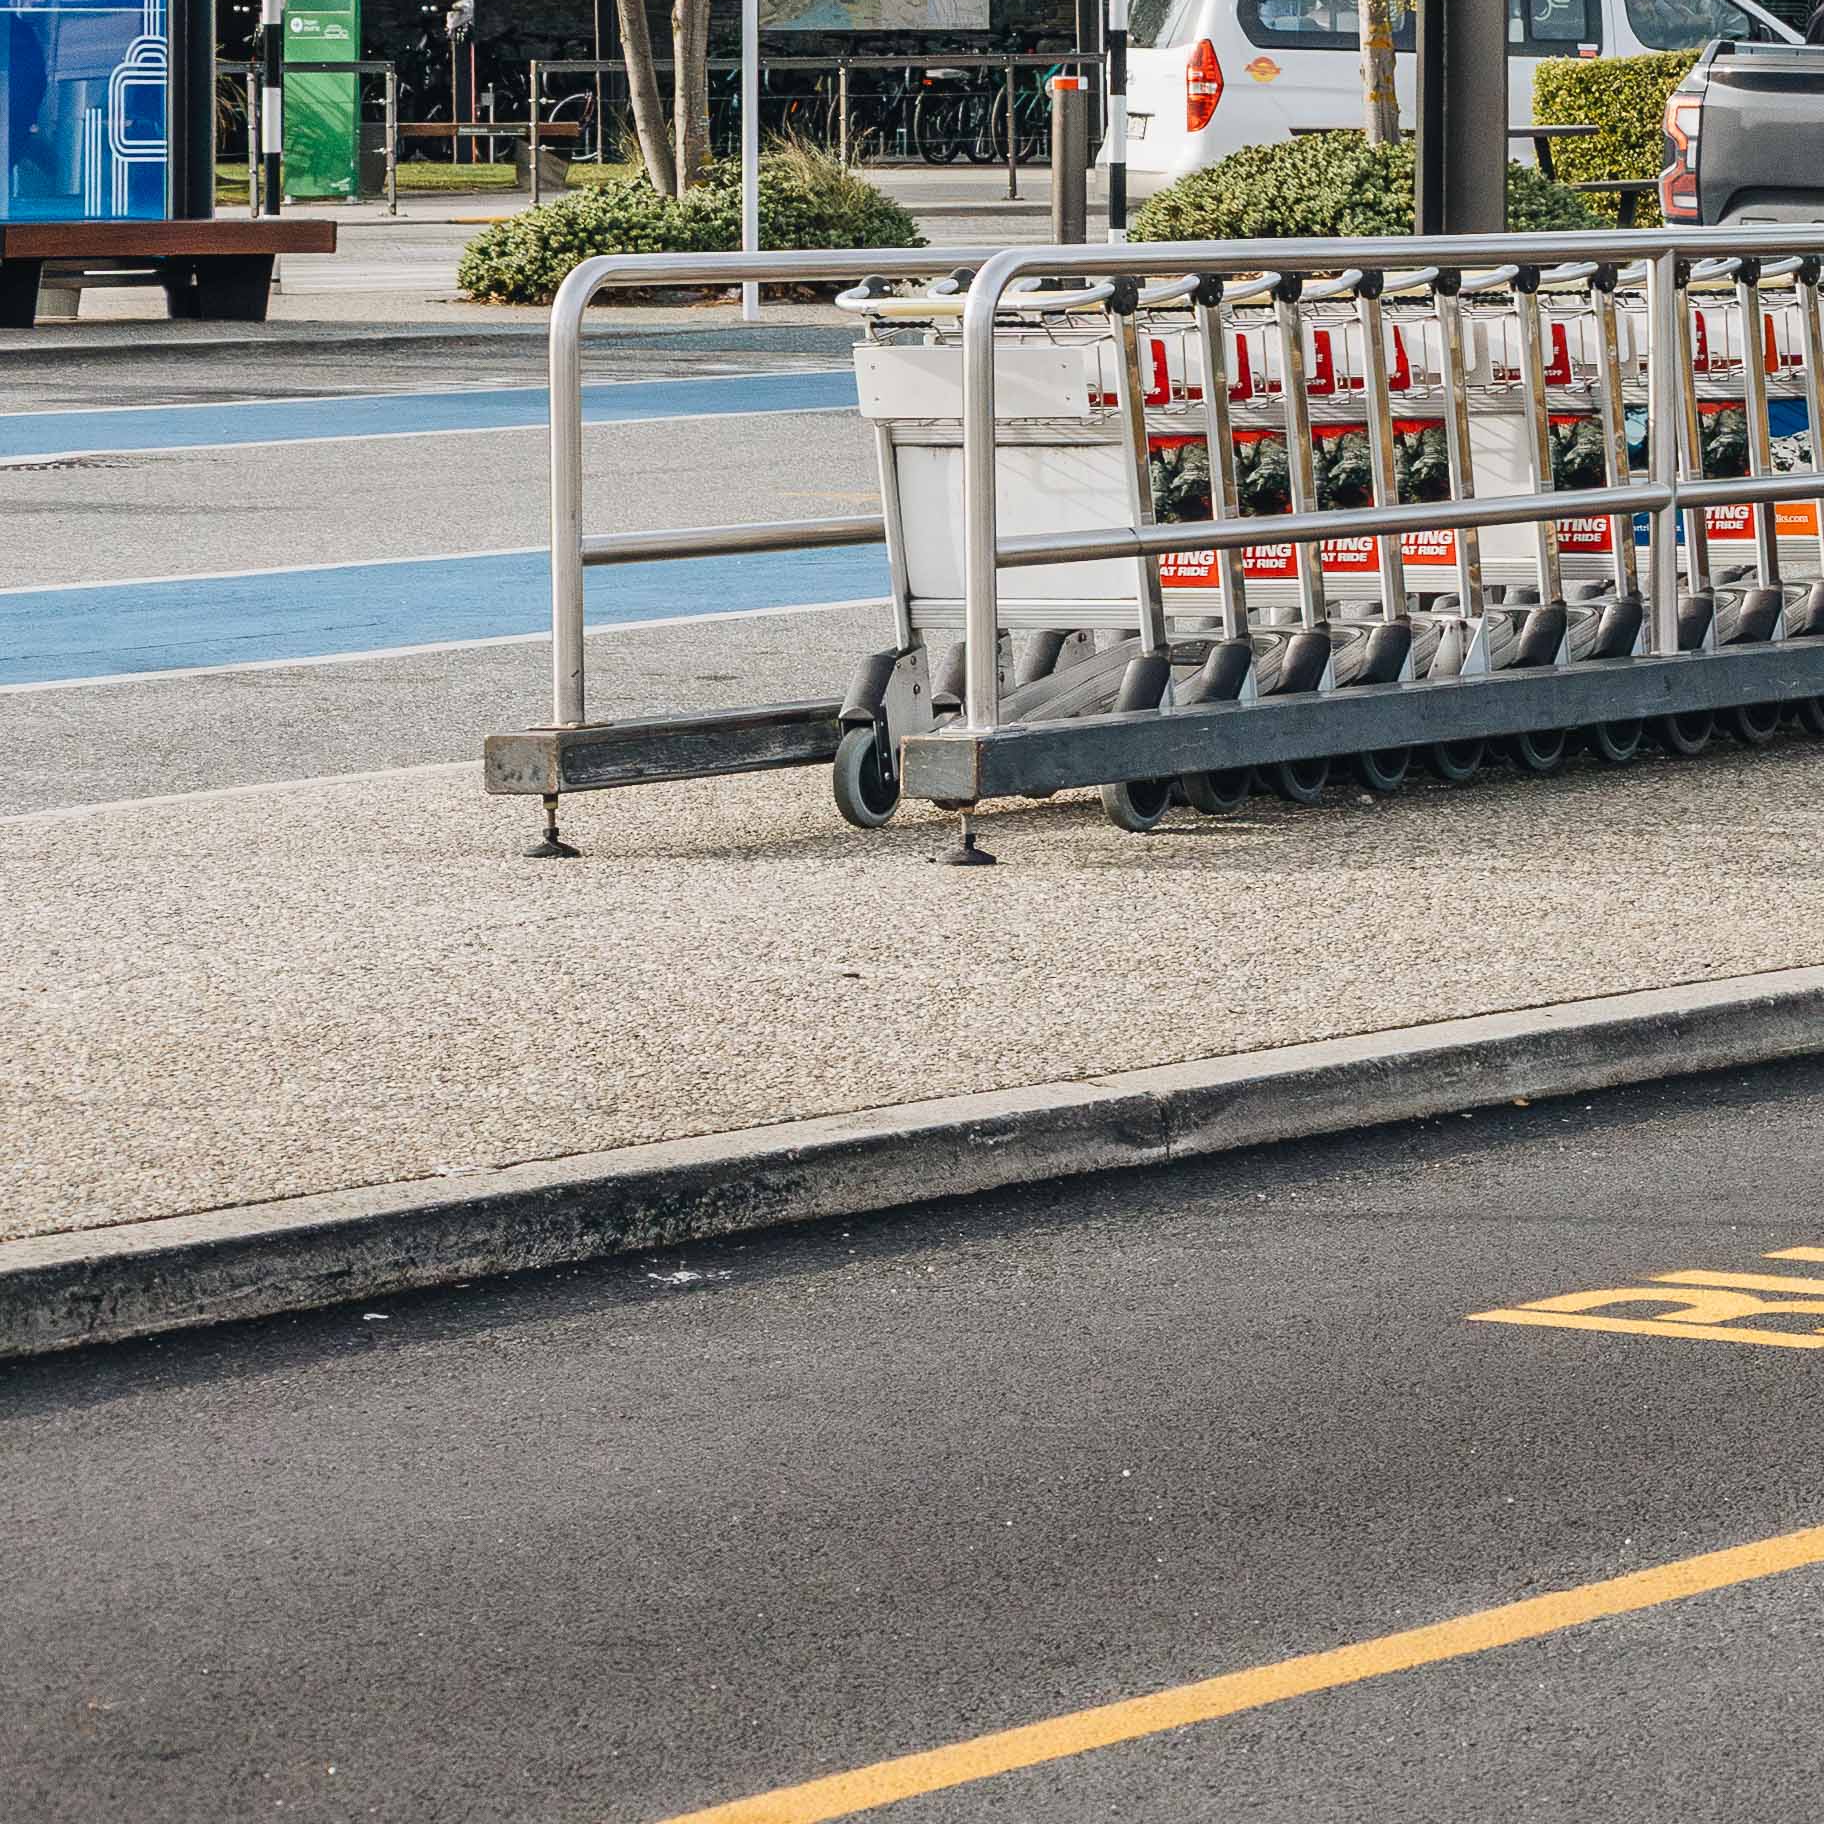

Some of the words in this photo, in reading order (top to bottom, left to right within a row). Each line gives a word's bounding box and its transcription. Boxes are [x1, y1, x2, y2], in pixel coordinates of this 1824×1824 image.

[1715, 520, 1744, 530] RIDE
[1572, 532, 1602, 542] RIDE
[1418, 545, 1448, 555] RIDE
[1337, 552, 1367, 562] RIDE
[1256, 558, 1286, 568] RIDE
[1177, 566, 1209, 576] RIDE
